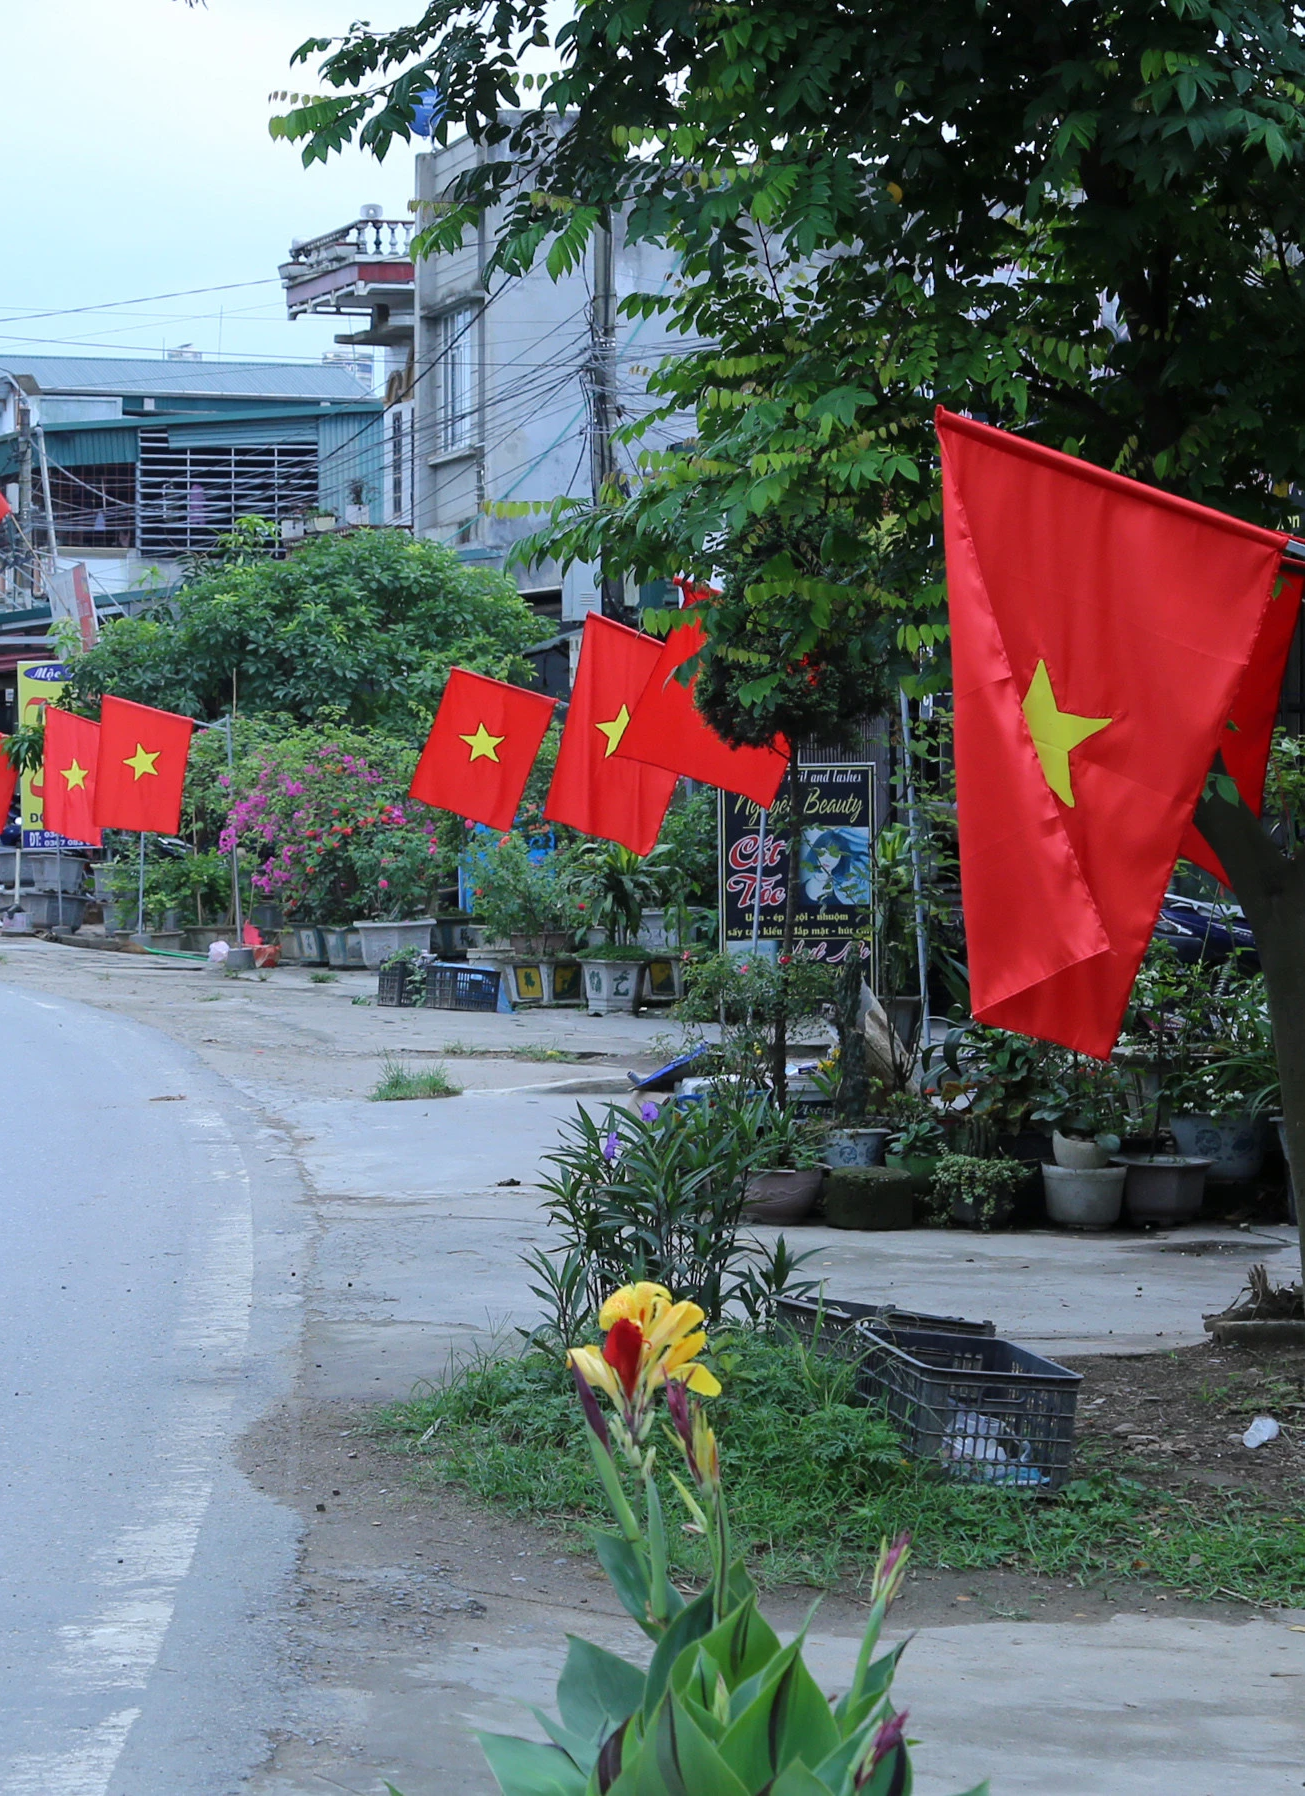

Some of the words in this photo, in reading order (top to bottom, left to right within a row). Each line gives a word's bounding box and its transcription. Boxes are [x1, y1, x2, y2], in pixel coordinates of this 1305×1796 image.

[811, 769, 829, 783] and
[832, 769, 862, 783] lashes
[804, 787, 863, 823] Beauty
[745, 913, 764, 921] Un
